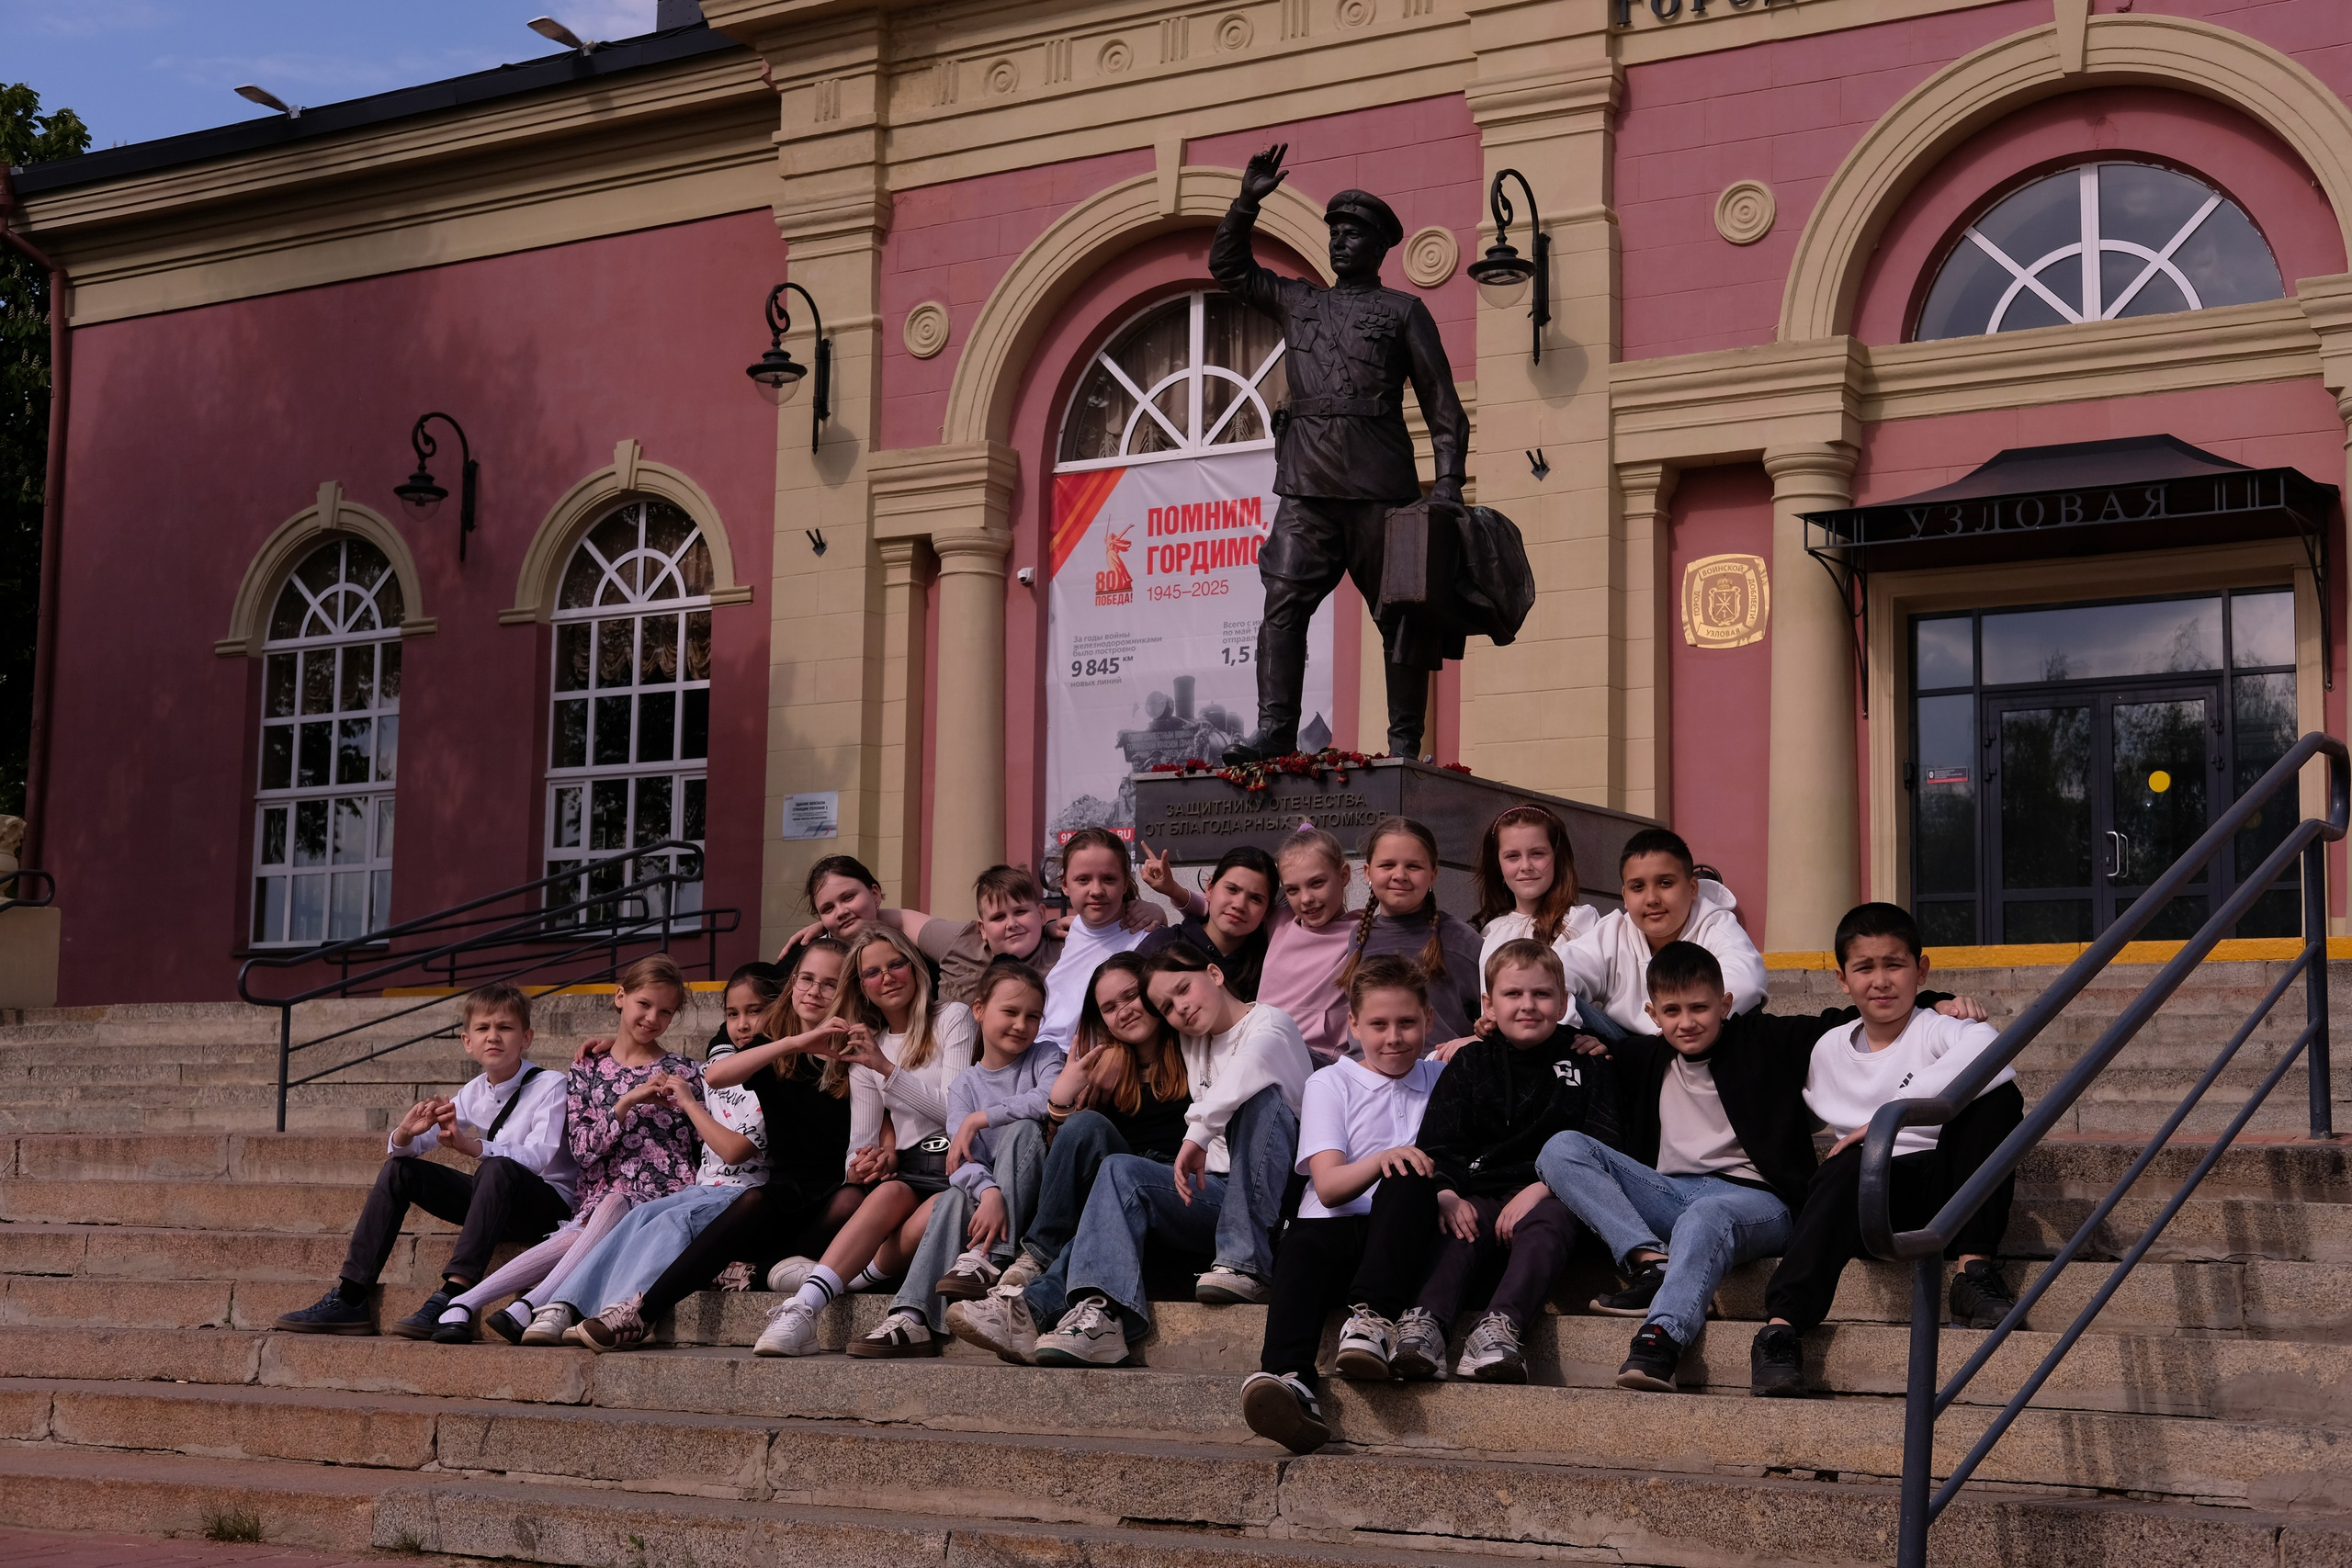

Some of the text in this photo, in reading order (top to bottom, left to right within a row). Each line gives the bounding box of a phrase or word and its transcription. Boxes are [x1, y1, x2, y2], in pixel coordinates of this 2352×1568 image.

[1148, 496, 1268, 537] ПОМНИМ,
[1904, 483, 2170, 539] УЗЛОВАЯ
[1147, 534, 1269, 576] ГОРДИМС
[1702, 565, 1744, 576] ВОИНСКОЙ
[1095, 570, 1116, 592] 80
[1095, 592, 1134, 606] ПОБЕДА!
[1693, 590, 1702, 616] ГОРОД
[1747, 578, 1758, 620] ДОБЛЕСТИ
[1073, 631, 1131, 643] За годы войны
[1235, 626, 1251, 635] май
[1705, 627, 1741, 637] УЗЛОВАЯ
[1073, 637, 1162, 649] железнодорожниками
[1222, 635, 1258, 644] отправл
[1072, 646, 1136, 657] было построено
[1097, 676, 1122, 685] линий
[1165, 793, 1367, 818] ЗАЩИТНИКУ ОТЕЧЕСТВА
[1144, 821, 1166, 837] ОТ
[1170, 815, 1291, 836] БЛАГОДАРНЫХ
